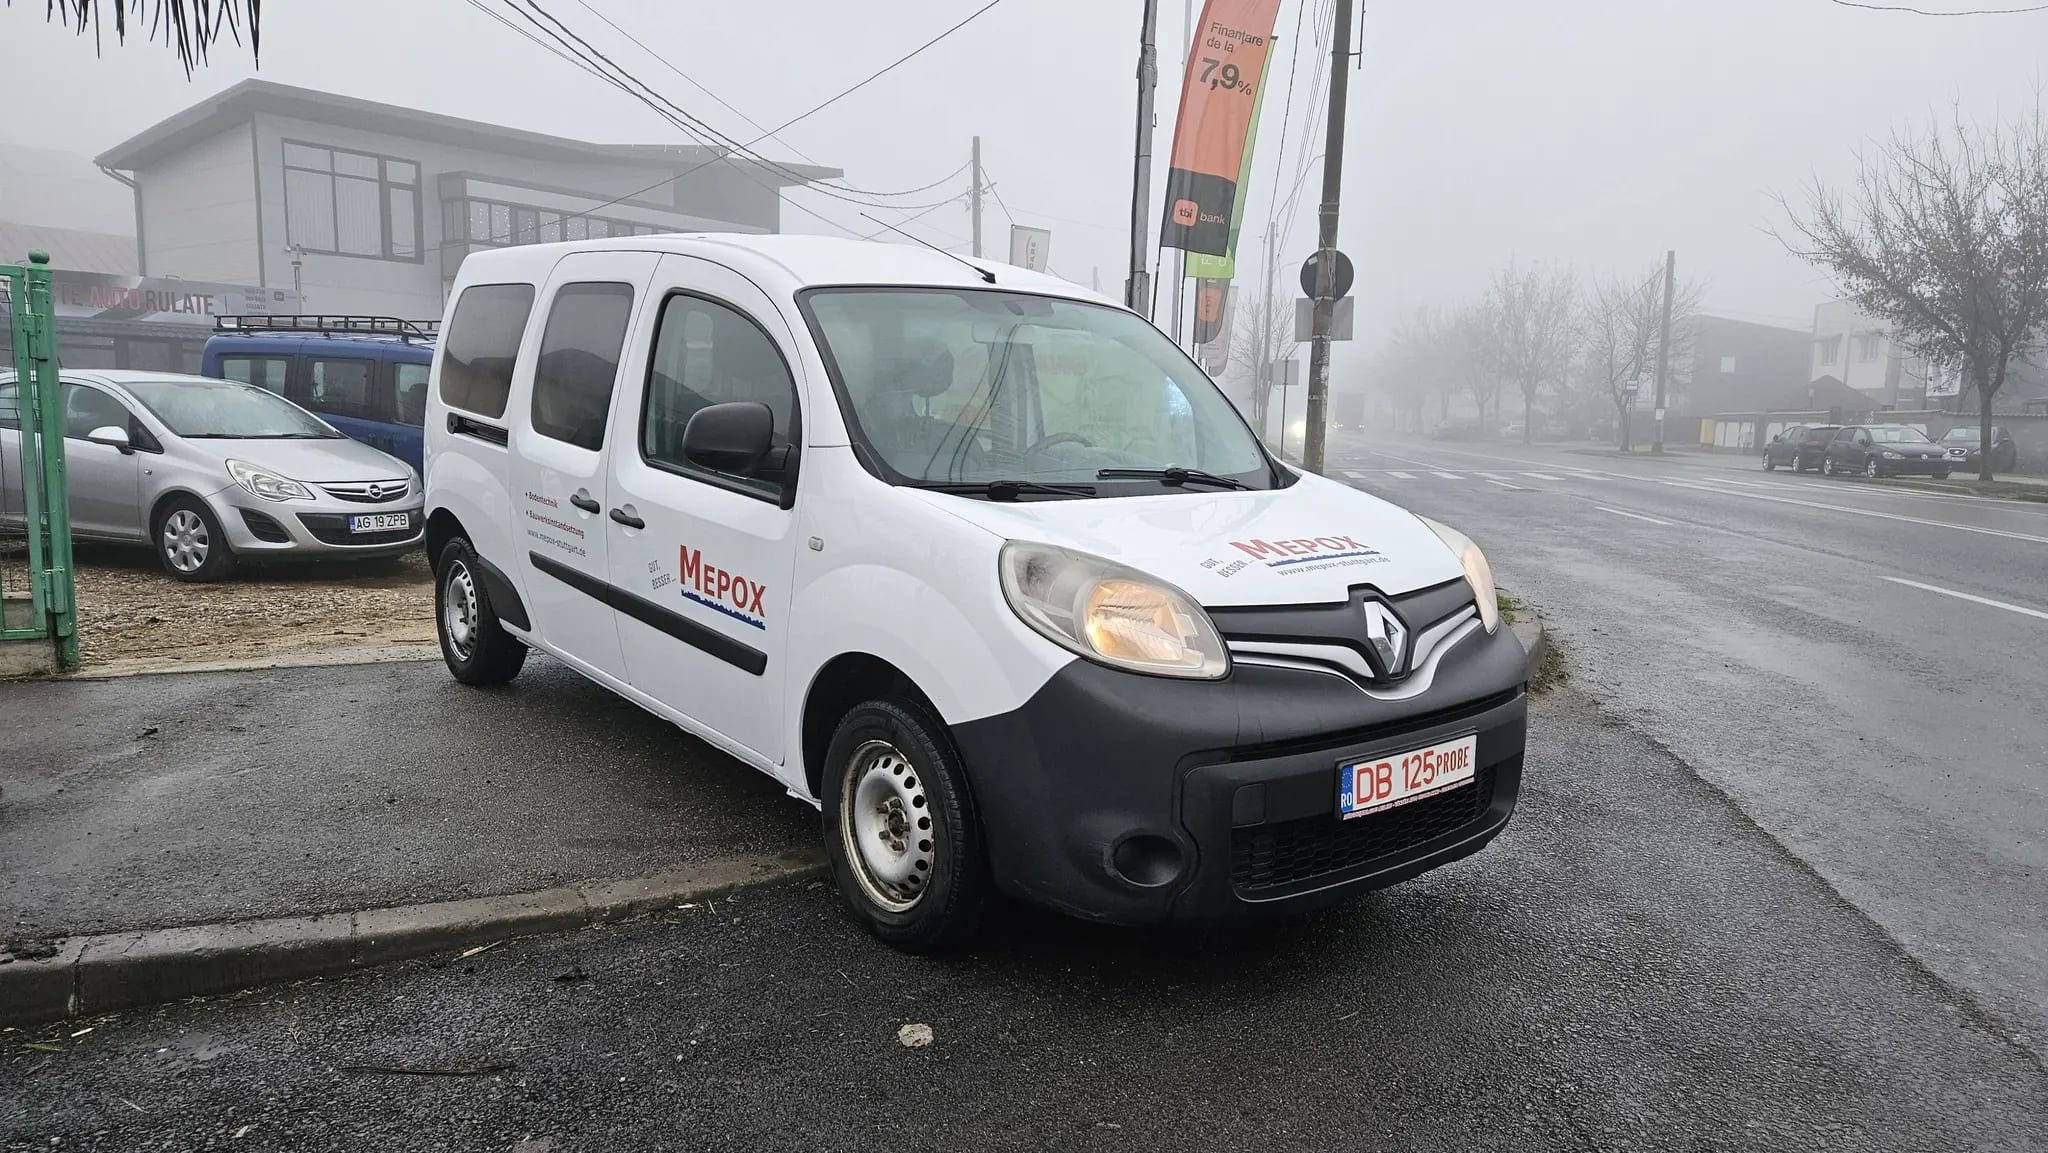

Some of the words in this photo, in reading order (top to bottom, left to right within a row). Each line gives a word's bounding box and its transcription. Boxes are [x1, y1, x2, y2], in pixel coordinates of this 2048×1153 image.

[1206, 37, 1221, 49] de
[1224, 40, 1234, 53] la
[1200, 57, 1252, 96] 7,9%
[1179, 207, 1193, 218] tbi
[1200, 212, 1225, 224] bank
[88, 286, 141, 311] AUTO
[145, 289, 215, 316] RULATE
[357, 516, 371, 529] AG
[374, 515, 385, 528] 19
[386, 514, 407, 527] ZPB
[1228, 535, 1371, 560] MEPOX
[680, 544, 766, 618] MEPOX
[1356, 762, 1393, 805] DB
[1401, 750, 1436, 792] 125
[1436, 746, 1470, 777] PROBE
[1341, 791, 1353, 808] RO
